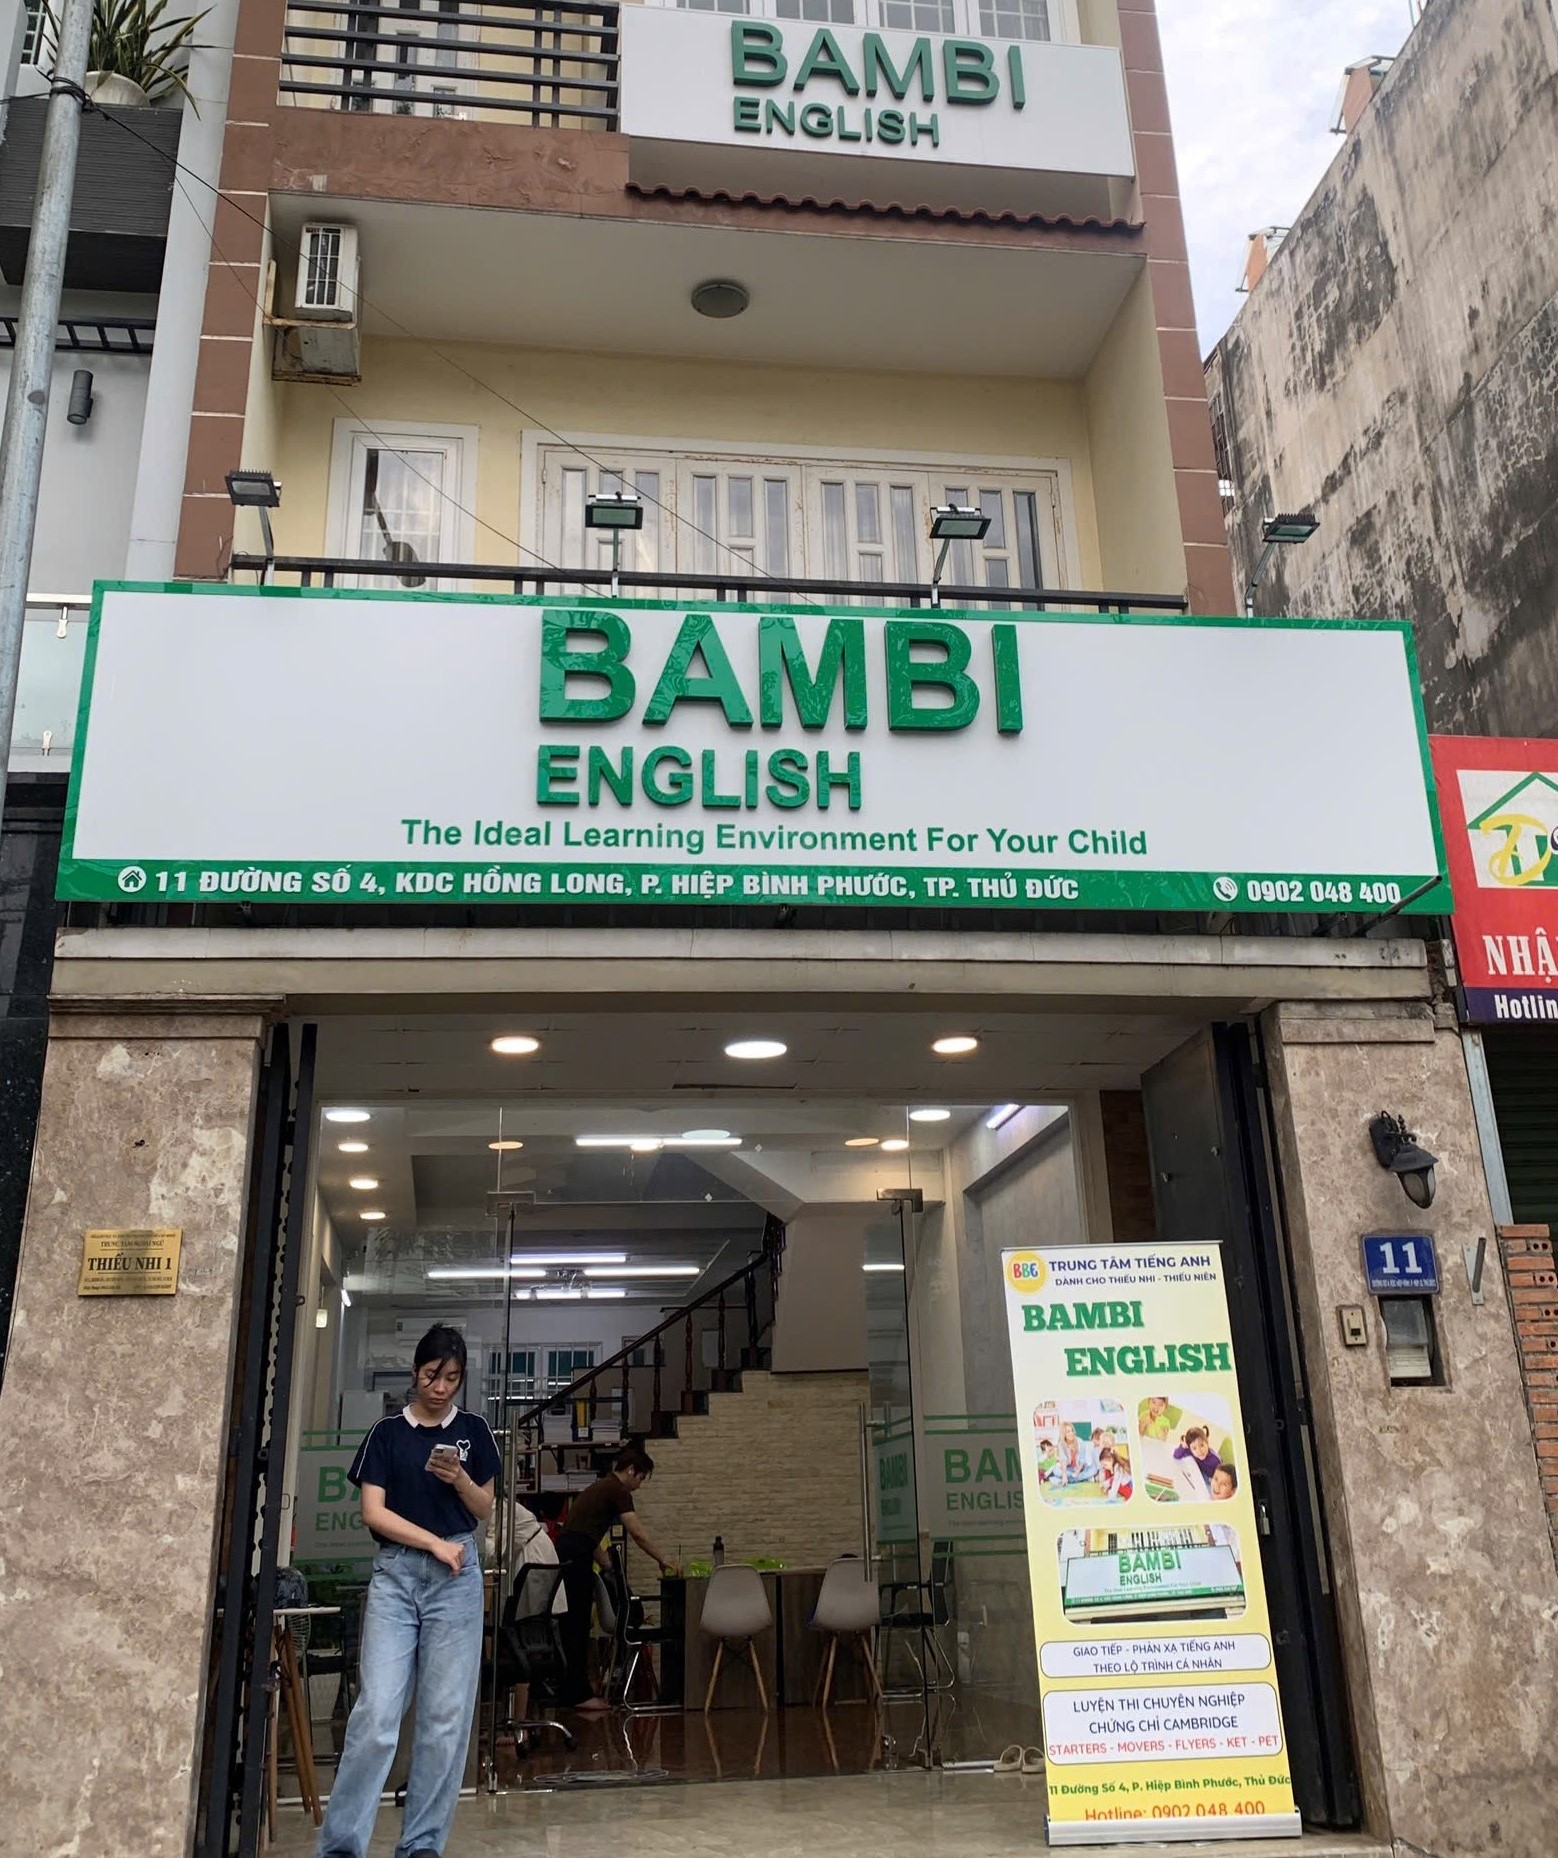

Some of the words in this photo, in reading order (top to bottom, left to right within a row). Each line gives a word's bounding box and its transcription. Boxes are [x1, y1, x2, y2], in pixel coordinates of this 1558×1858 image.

[731, 20, 1025, 110] BAMBI
[734, 96, 939, 147] ENGLISH
[540, 609, 1023, 733] BAMBI
[536, 744, 861, 810] ENGLISH
[401, 819, 462, 846] The
[474, 820, 551, 847] Ideal
[563, 821, 704, 855] Learning
[716, 823, 918, 851] Environment
[926, 827, 979, 852] For
[986, 828, 1059, 853] Your
[1067, 829, 1148, 855] Child
[155, 871, 187, 892] 11
[199, 866, 302, 893] ĐƯỜNG
[311, 864, 351, 893] SỐ
[359, 872, 386, 896] 4,
[395, 872, 453, 893] KDC
[463, 865, 542, 894] HỒNG
[550, 872, 632, 897] LONG,
[640, 873, 662, 894] P.
[671, 870, 735, 899] HIỆP
[743, 870, 808, 895] BÌNH
[817, 871, 916, 899] PHƯỚC,
[923, 876, 959, 898] TP.
[966, 871, 1017, 899] THỦ
[1025, 874, 1079, 900] ĐỨC
[1247, 880, 1304, 902] 0902
[1309, 881, 1353, 903] 048
[1358, 882, 1401, 904] 400
[1482, 927, 1558, 983] NHẬ
[87, 1252, 132, 1271] THIẾU
[135, 1257, 161, 1270] NHI
[165, 1257, 172, 1270] 1
[1049, 1259, 1097, 1272] TRUNG
[1100, 1255, 1131, 1270] TÂM
[1134, 1253, 1176, 1269] TIẾNG
[1180, 1255, 1211, 1267] ANH
[1379, 1241, 1423, 1274] 11
[1055, 1275, 1083, 1286] DÀNH
[1085, 1276, 1106, 1285] CHO
[1108, 1273, 1136, 1284] THIẾU
[1139, 1275, 1156, 1283] NHI
[1163, 1272, 1191, 1282] THIẾU
[1193, 1271, 1217, 1281] NIÊN
[1021, 1300, 1144, 1332] BAMBI
[1064, 1342, 1232, 1377] ENGLISH
[1118, 1550, 1182, 1573] BAMBI
[1120, 1573, 1162, 1586] ENGLISH
[1073, 1646, 1098, 1657] GIAO
[1101, 1643, 1123, 1656] TIẾP
[1132, 1641, 1161, 1655] PHẢN
[1163, 1643, 1178, 1655] XẠ
[1180, 1639, 1211, 1652] TIẾNG
[1214, 1641, 1235, 1651] ANH
[1093, 1662, 1122, 1673] THEO
[1124, 1660, 1139, 1675] LỘ
[1141, 1659, 1173, 1671] TRÌNH
[1176, 1659, 1189, 1670] CÁ
[1192, 1658, 1222, 1669] NHÂN
[1073, 1697, 1115, 1714] LUYỆN
[1118, 1699, 1140, 1711] THI
[1143, 1694, 1195, 1710] CHUYÊN
[1198, 1691, 1245, 1709] NGHIỆP
[1089, 1716, 1135, 1734] CHỨNG
[1138, 1715, 1160, 1732] CHỈ
[1163, 1716, 1239, 1731] CAMBRIDGE
[1049, 1743, 1107, 1756] STARTERS
[1117, 1740, 1165, 1753] MOVERS
[1175, 1738, 1216, 1751] FLYERS
[1227, 1736, 1248, 1748] KET
[1258, 1735, 1279, 1747] PET
[1050, 1785, 1058, 1795] 11
[1061, 1783, 1099, 1795] Đường
[1102, 1781, 1116, 1793] Số
[1118, 1783, 1130, 1794] 4,
[1132, 1781, 1144, 1791] P.
[1146, 1780, 1171, 1793] Hiệp
[1174, 1777, 1200, 1789] Bình
[1203, 1775, 1242, 1789] Phước,
[1244, 1774, 1265, 1786] Thủ
[1268, 1774, 1291, 1785] Đức
[1195, 1802, 1227, 1816] 048
[1234, 1800, 1265, 1815] 400
